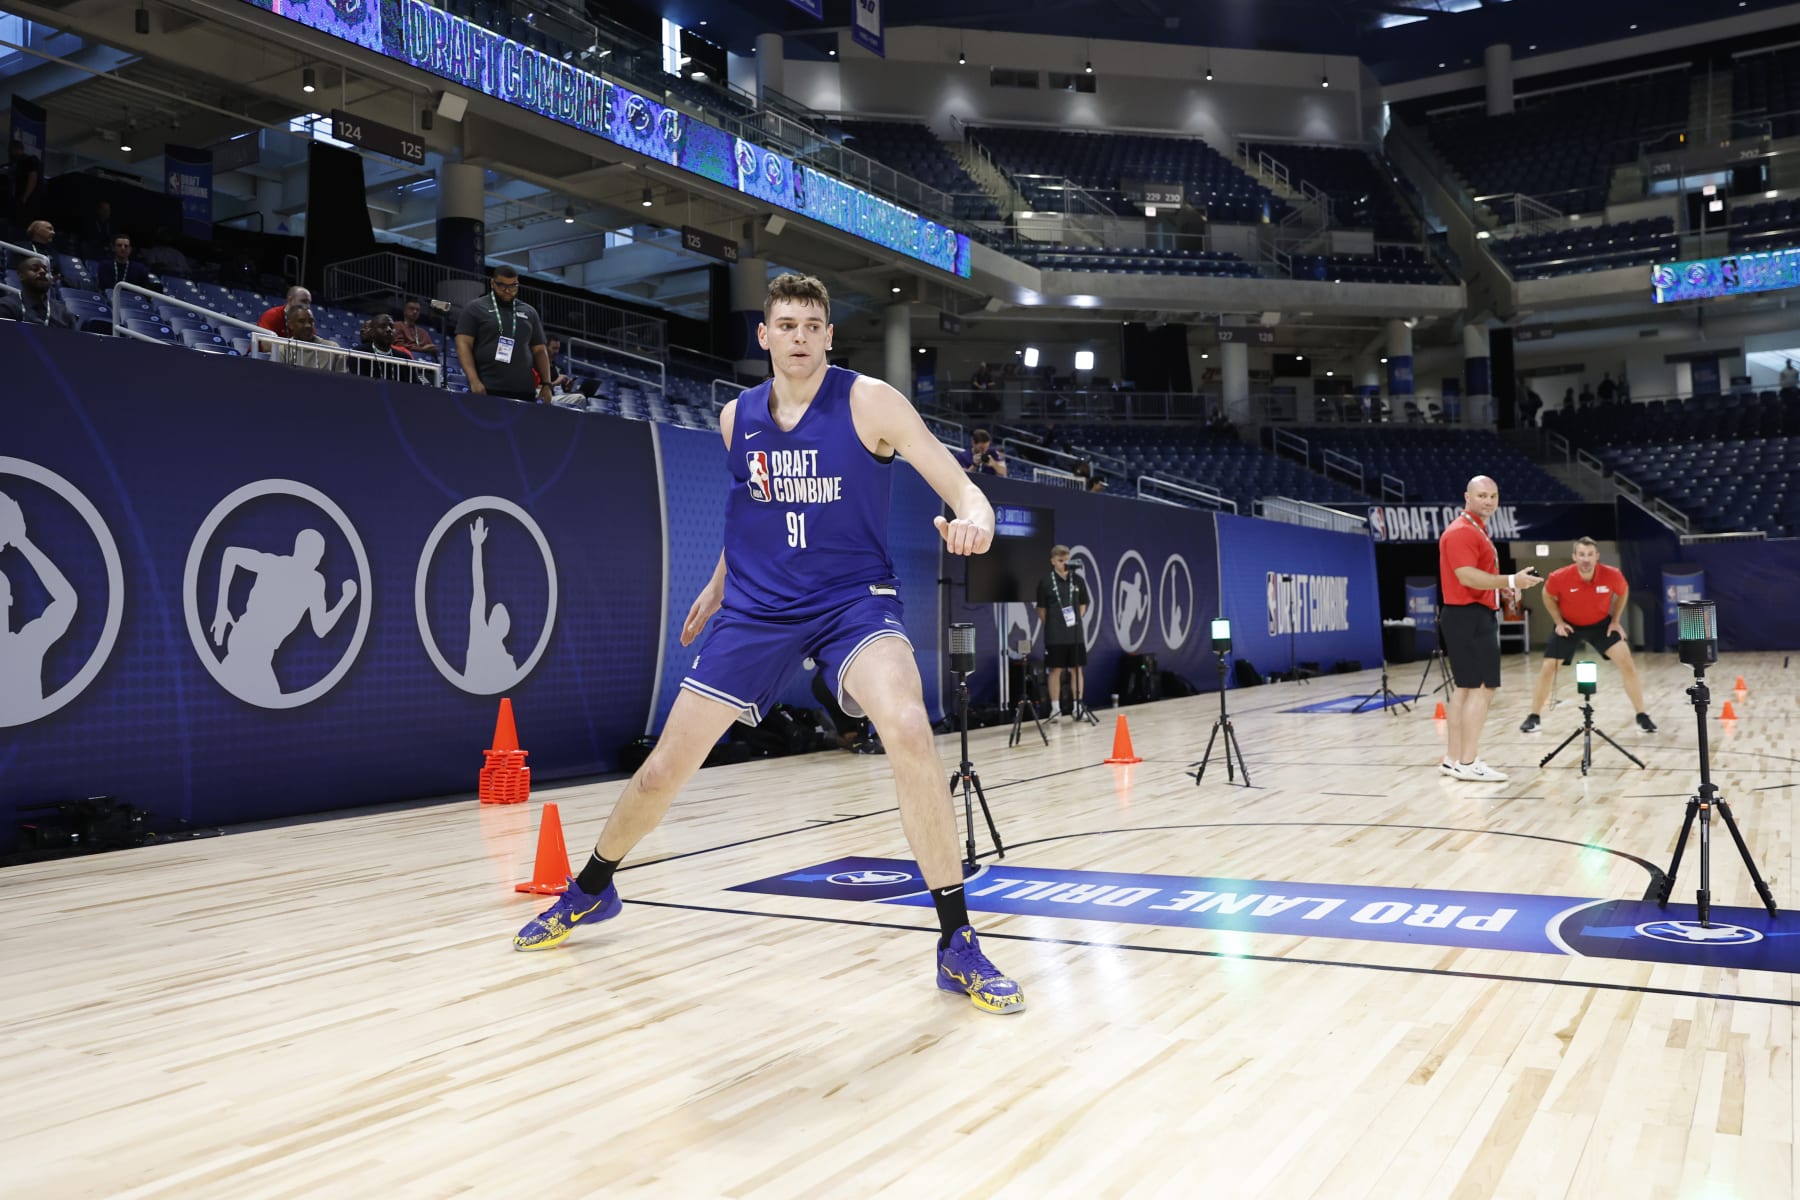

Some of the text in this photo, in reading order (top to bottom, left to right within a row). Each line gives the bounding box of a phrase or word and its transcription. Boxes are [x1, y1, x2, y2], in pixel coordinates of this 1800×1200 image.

[408, 0, 614, 134] DRAFT COMBINE
[338, 121, 422, 159] 124 125
[687, 234, 701, 248] 125
[771, 449, 819, 477] DRAFT
[773, 476, 843, 504] COMBINE
[786, 511, 807, 549] 91
[1385, 506, 1440, 540] DRAFT
[1277, 573, 1349, 635] DRAFT COMBINE
[968, 878, 1519, 932] PRO LANE DRILL
